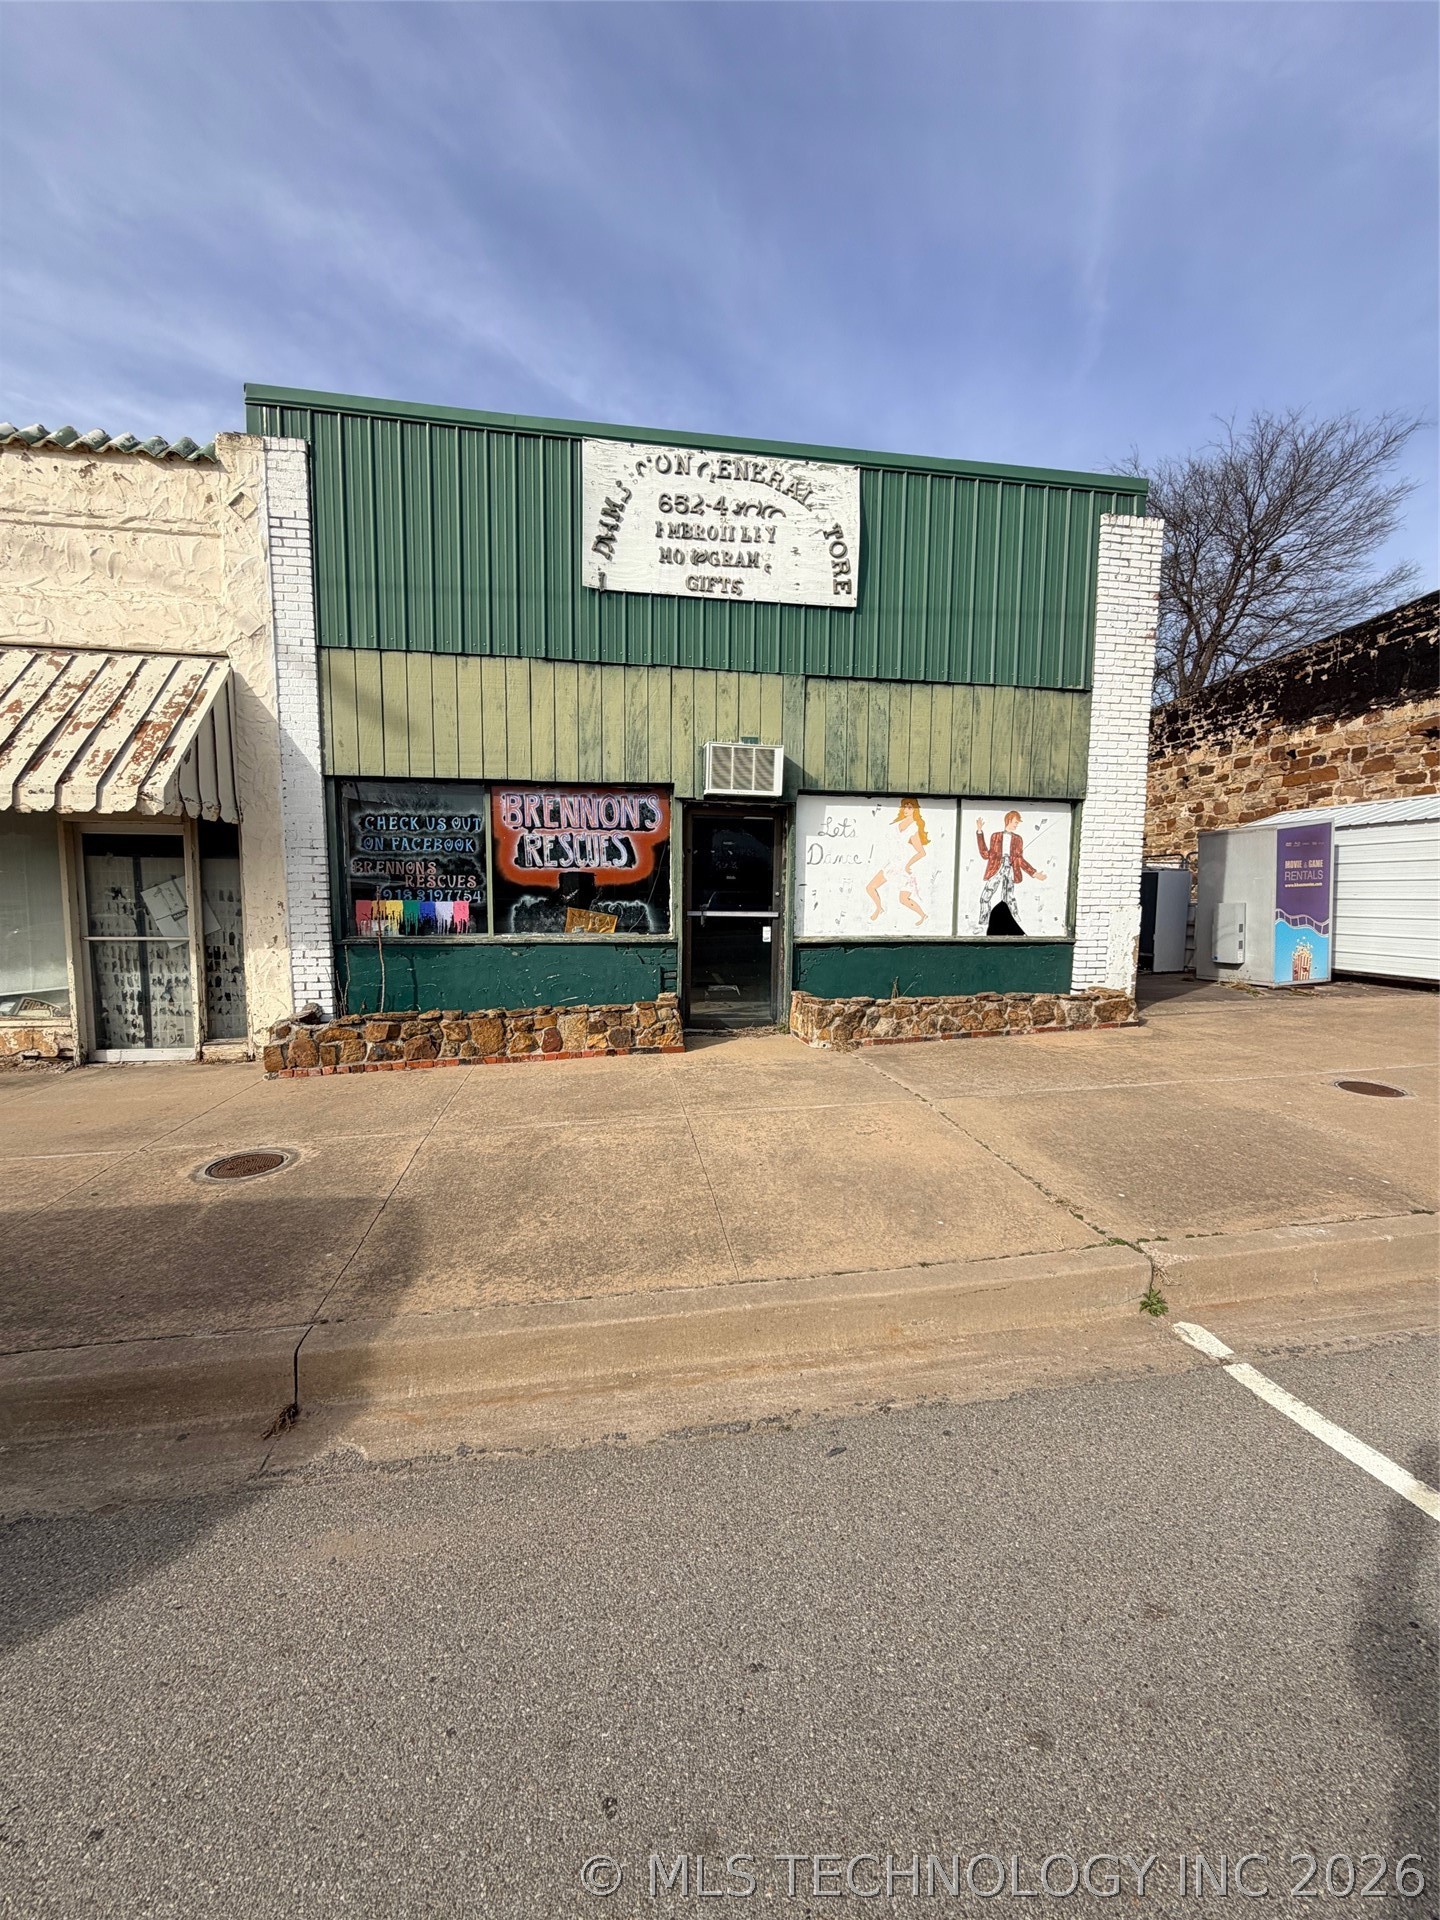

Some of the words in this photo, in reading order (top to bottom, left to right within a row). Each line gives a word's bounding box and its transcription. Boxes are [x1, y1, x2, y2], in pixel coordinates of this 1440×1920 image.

[821, 522, 853, 596] TORE
[685, 573, 745, 597] GIFTS
[503, 793, 663, 829] BRENNON'S
[364, 815, 420, 831] CHECK
[426, 816, 447, 831] US
[451, 817, 482, 832] OUT
[817, 815, 858, 838] Let's
[363, 837, 384, 850] ON
[391, 837, 475, 852] FACEBOOK
[523, 832, 628, 868] RESCUES
[353, 860, 437, 876] BRENNONS
[1285, 860, 1303, 869] MOVIE
[1308, 859, 1323, 868] GAME
[405, 875, 478, 889] RESCUES
[1285, 870, 1323, 881] RENTALS
